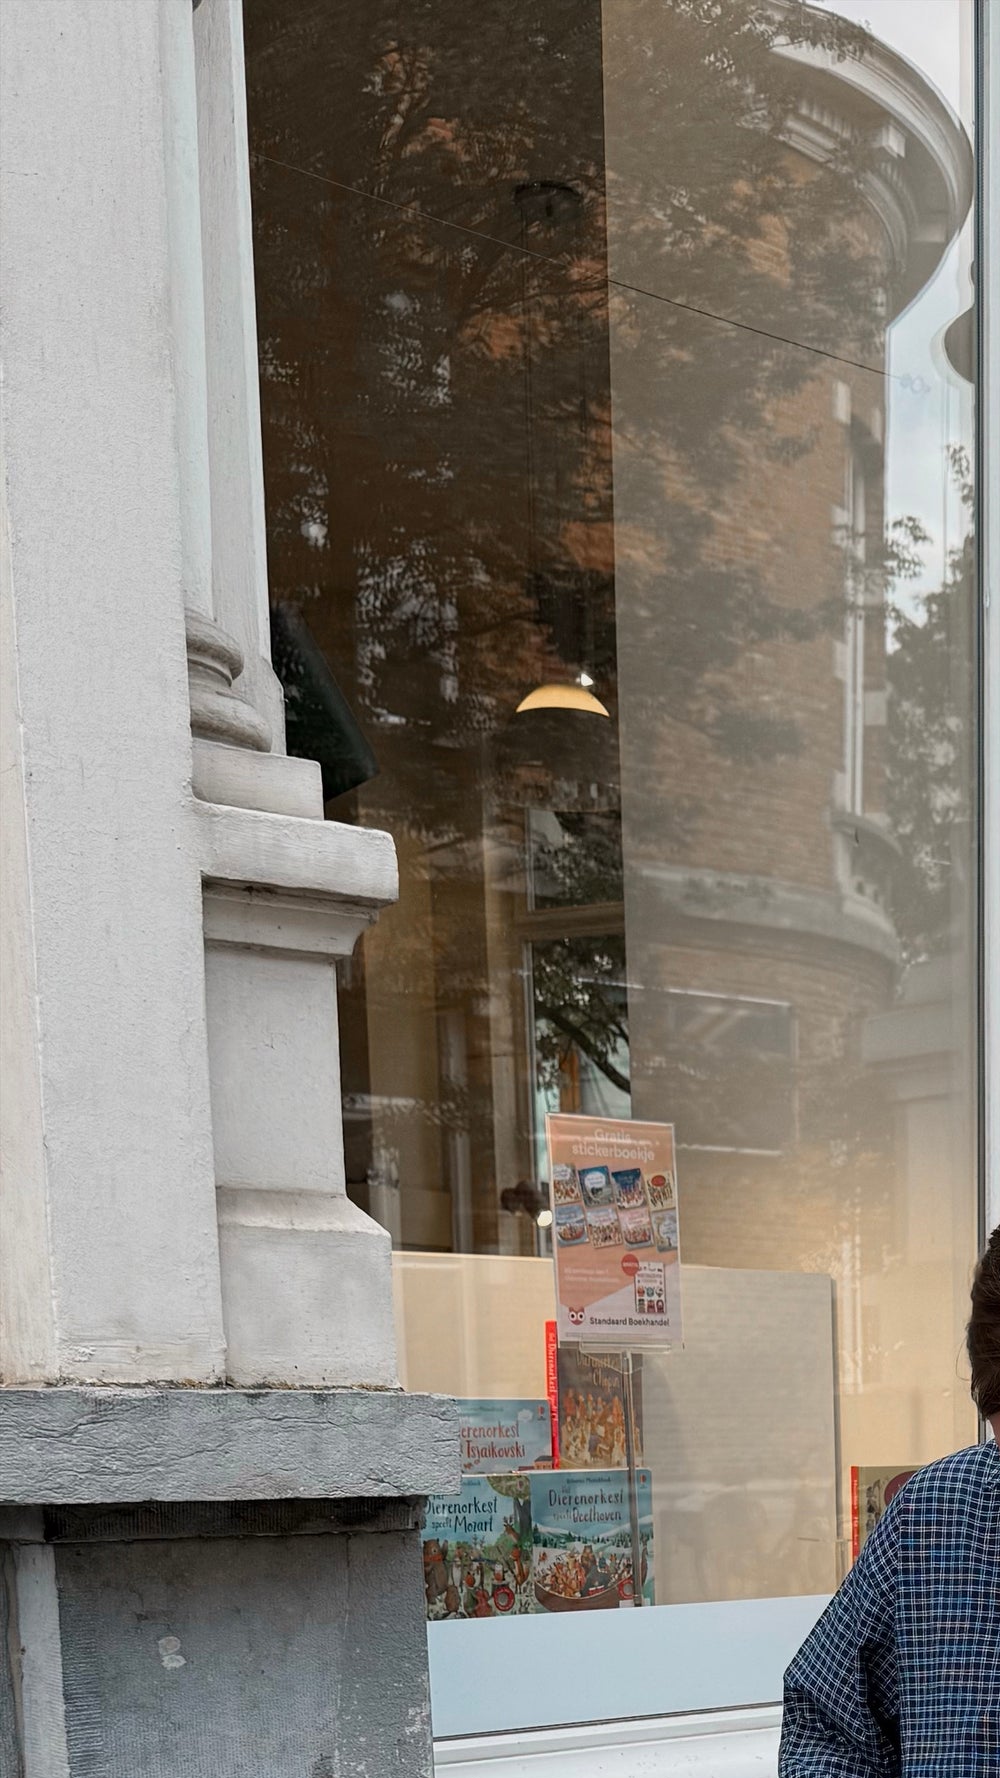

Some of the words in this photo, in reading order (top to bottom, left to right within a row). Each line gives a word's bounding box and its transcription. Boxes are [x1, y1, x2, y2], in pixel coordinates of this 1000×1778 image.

[594, 1129, 631, 1143] Gratis
[572, 1142, 655, 1162] stickerboekje
[590, 1317, 627, 1326] Standaard
[628, 1318, 670, 1327] Boekhandel
[466, 1440, 525, 1459] Tsjaikovski
[548, 1489, 624, 1506] Dierenorkest
[572, 1505, 622, 1523] Beethoven
[454, 1515, 493, 1533] Mozart
